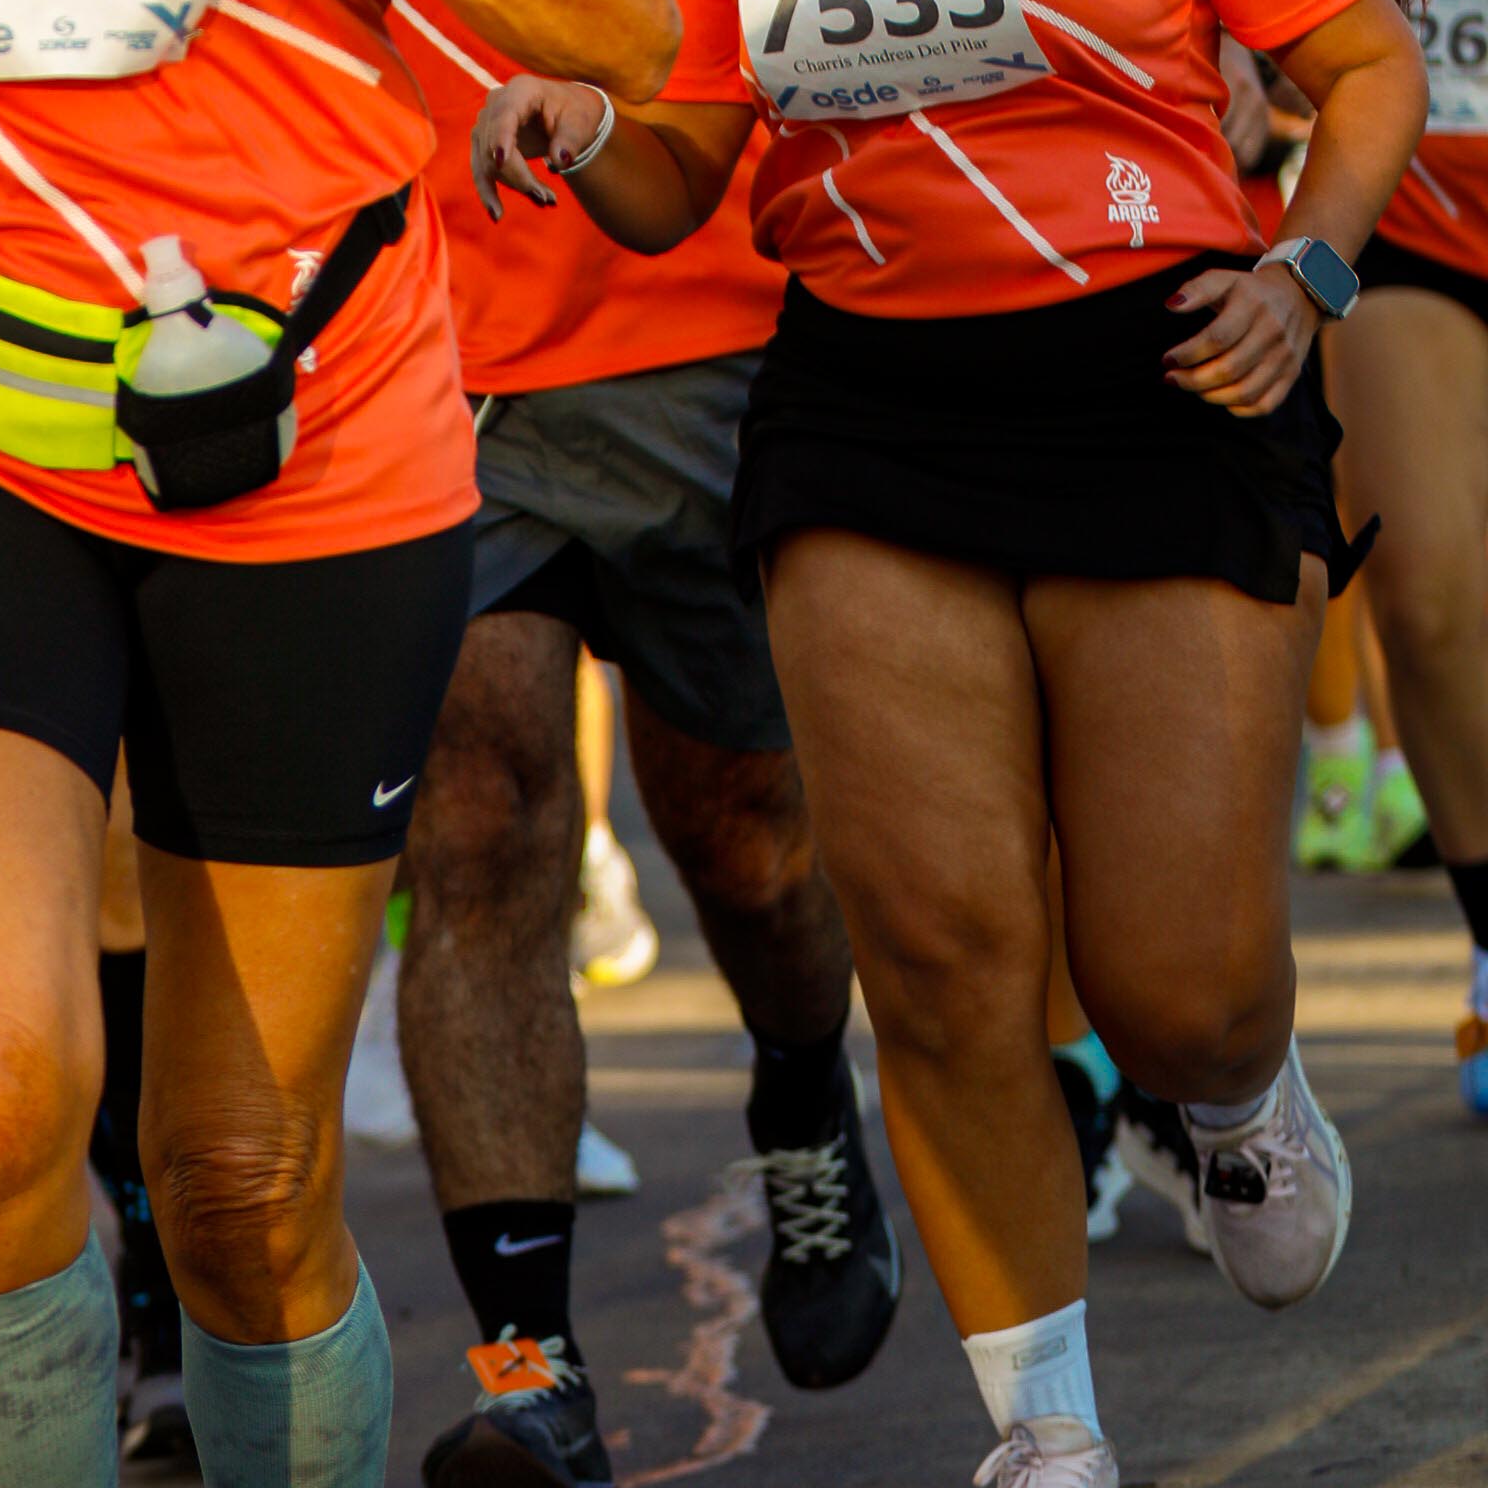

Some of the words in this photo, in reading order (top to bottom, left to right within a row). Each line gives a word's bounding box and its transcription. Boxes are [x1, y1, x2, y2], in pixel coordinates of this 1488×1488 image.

[793, 55, 852, 74] Charris
[858, 48, 915, 66] Andrea
[917, 41, 947, 58] Del
[950, 37, 989, 54] Pilar
[812, 80, 899, 110] osde
